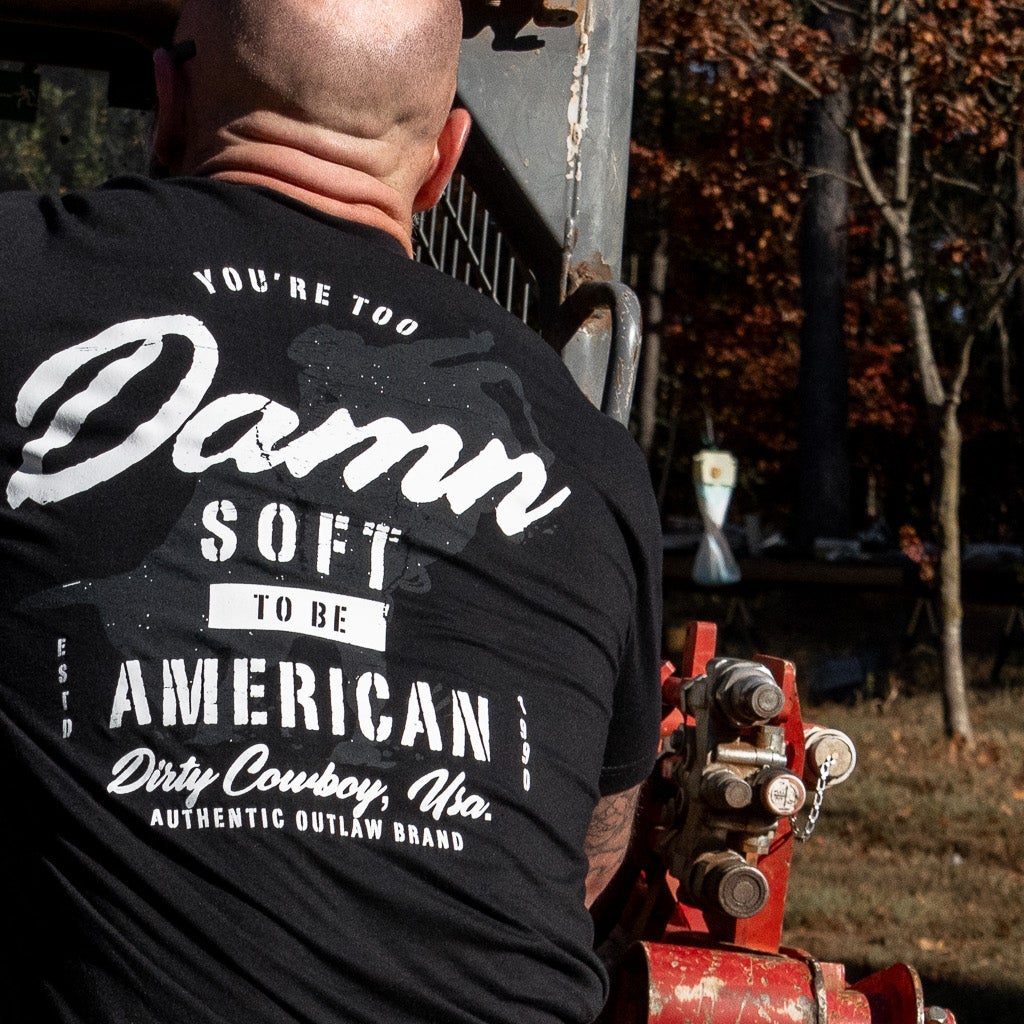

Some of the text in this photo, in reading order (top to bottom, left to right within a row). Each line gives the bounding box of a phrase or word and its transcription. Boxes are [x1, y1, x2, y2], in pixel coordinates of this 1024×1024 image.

[192, 266, 419, 336] YOU'RE TOO
[5, 313, 572, 537] Damn
[200, 499, 403, 591] SOFT
[253, 594, 347, 634] TO BE
[109, 657, 491, 763] AMERICAN
[106, 747, 221, 809] Dirty
[222, 743, 389, 819] Cowboy,
[149, 807, 464, 852] AUTHENTIC OUTLAW BRAND
